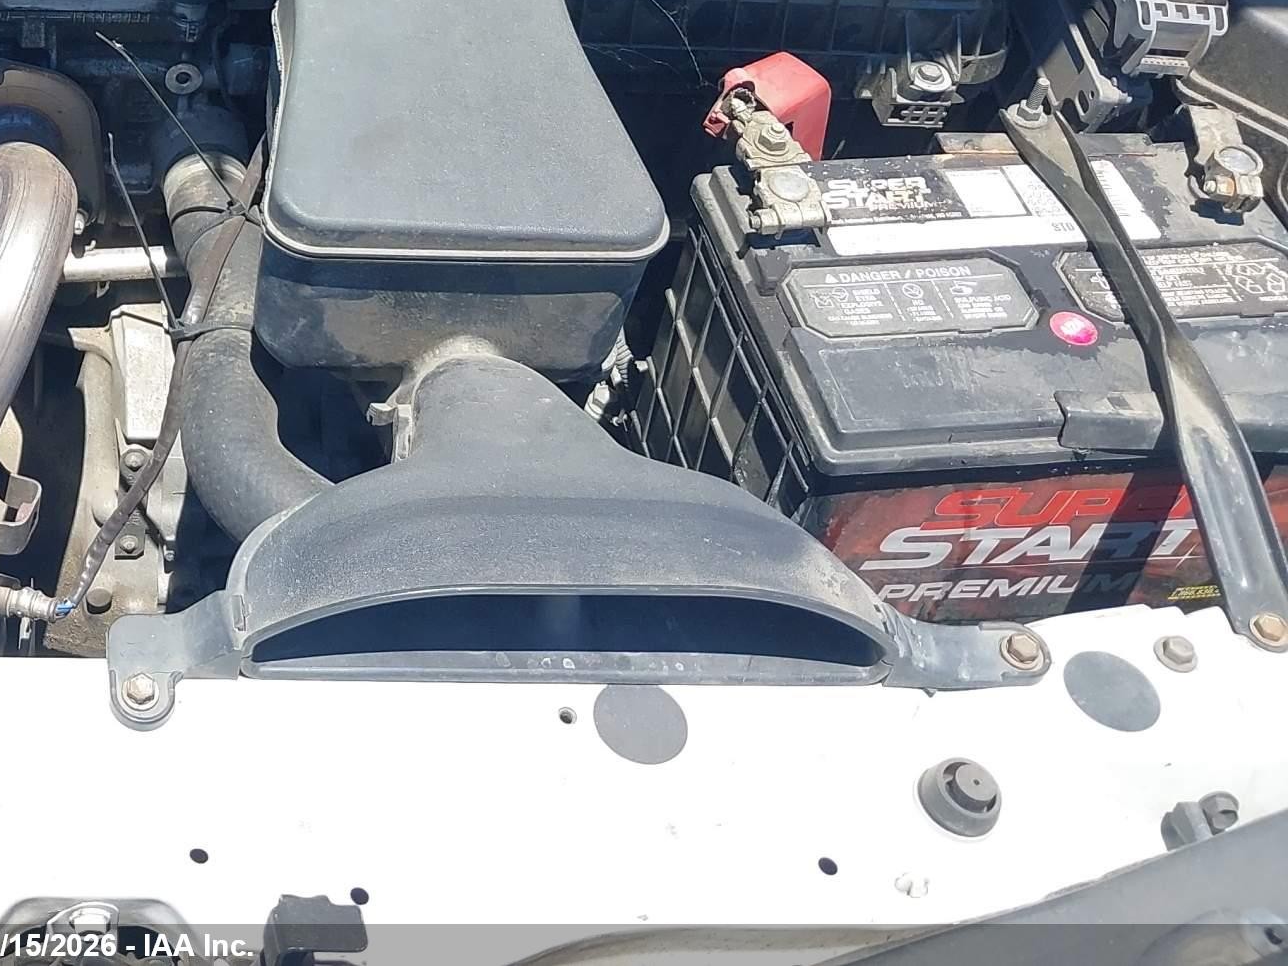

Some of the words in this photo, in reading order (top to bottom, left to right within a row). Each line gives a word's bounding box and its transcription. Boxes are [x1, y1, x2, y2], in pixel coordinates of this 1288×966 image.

[838, 269, 902, 284] DANGER
[915, 265, 972, 278] POISON
[861, 518, 1201, 571] START
[875, 572, 1140, 602] PREMIUM
